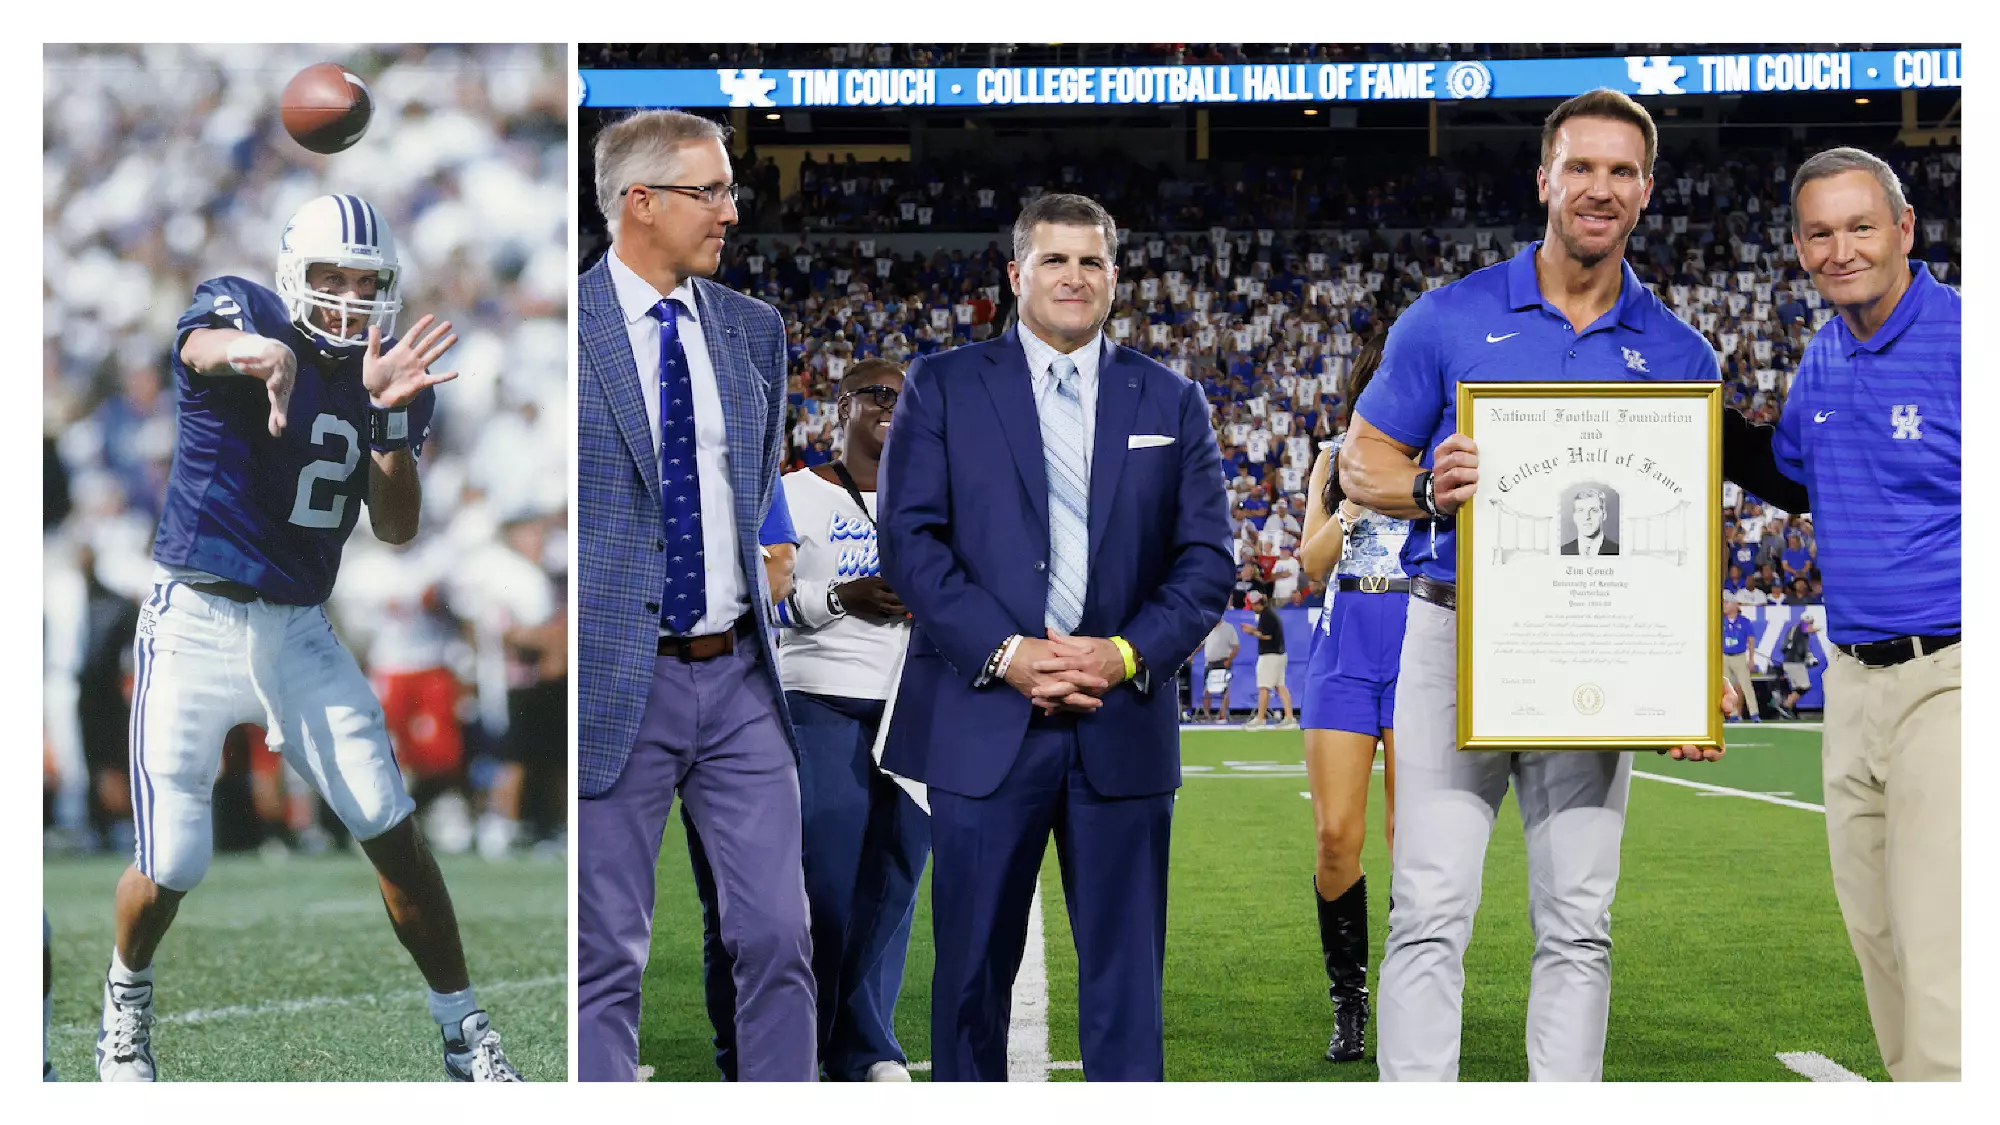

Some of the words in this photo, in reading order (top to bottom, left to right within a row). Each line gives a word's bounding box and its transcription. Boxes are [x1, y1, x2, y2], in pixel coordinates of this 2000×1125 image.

[717, 69, 776, 107] UK
[788, 69, 838, 104] TIM
[846, 69, 936, 104] COUCH
[977, 67, 1094, 103] COLLEGE
[1100, 66, 1238, 102] FOOTBALL
[1244, 65, 1313, 100] HALL
[1319, 64, 1354, 99] OF
[1361, 63, 1435, 98] FAME
[1624, 56, 1686, 95] UK
[1698, 55, 1749, 91] TIM
[1756, 54, 1851, 90] COUCH
[1894, 51, 1961, 87] COLL
[1490, 408, 1546, 423] National
[1553, 408, 1609, 423] Football
[1617, 408, 1693, 423] Foundation
[1580, 428, 1603, 440] and
[1891, 404, 1923, 440] UK
[288, 413, 361, 528] 2
[1498, 456, 1559, 492] College
[1567, 447, 1608, 465] Hall
[1615, 453, 1635, 467] of
[1637, 457, 1683, 494] Fame
[1565, 566, 1583, 576] Tim
[1586, 566, 1614, 576] Couch
